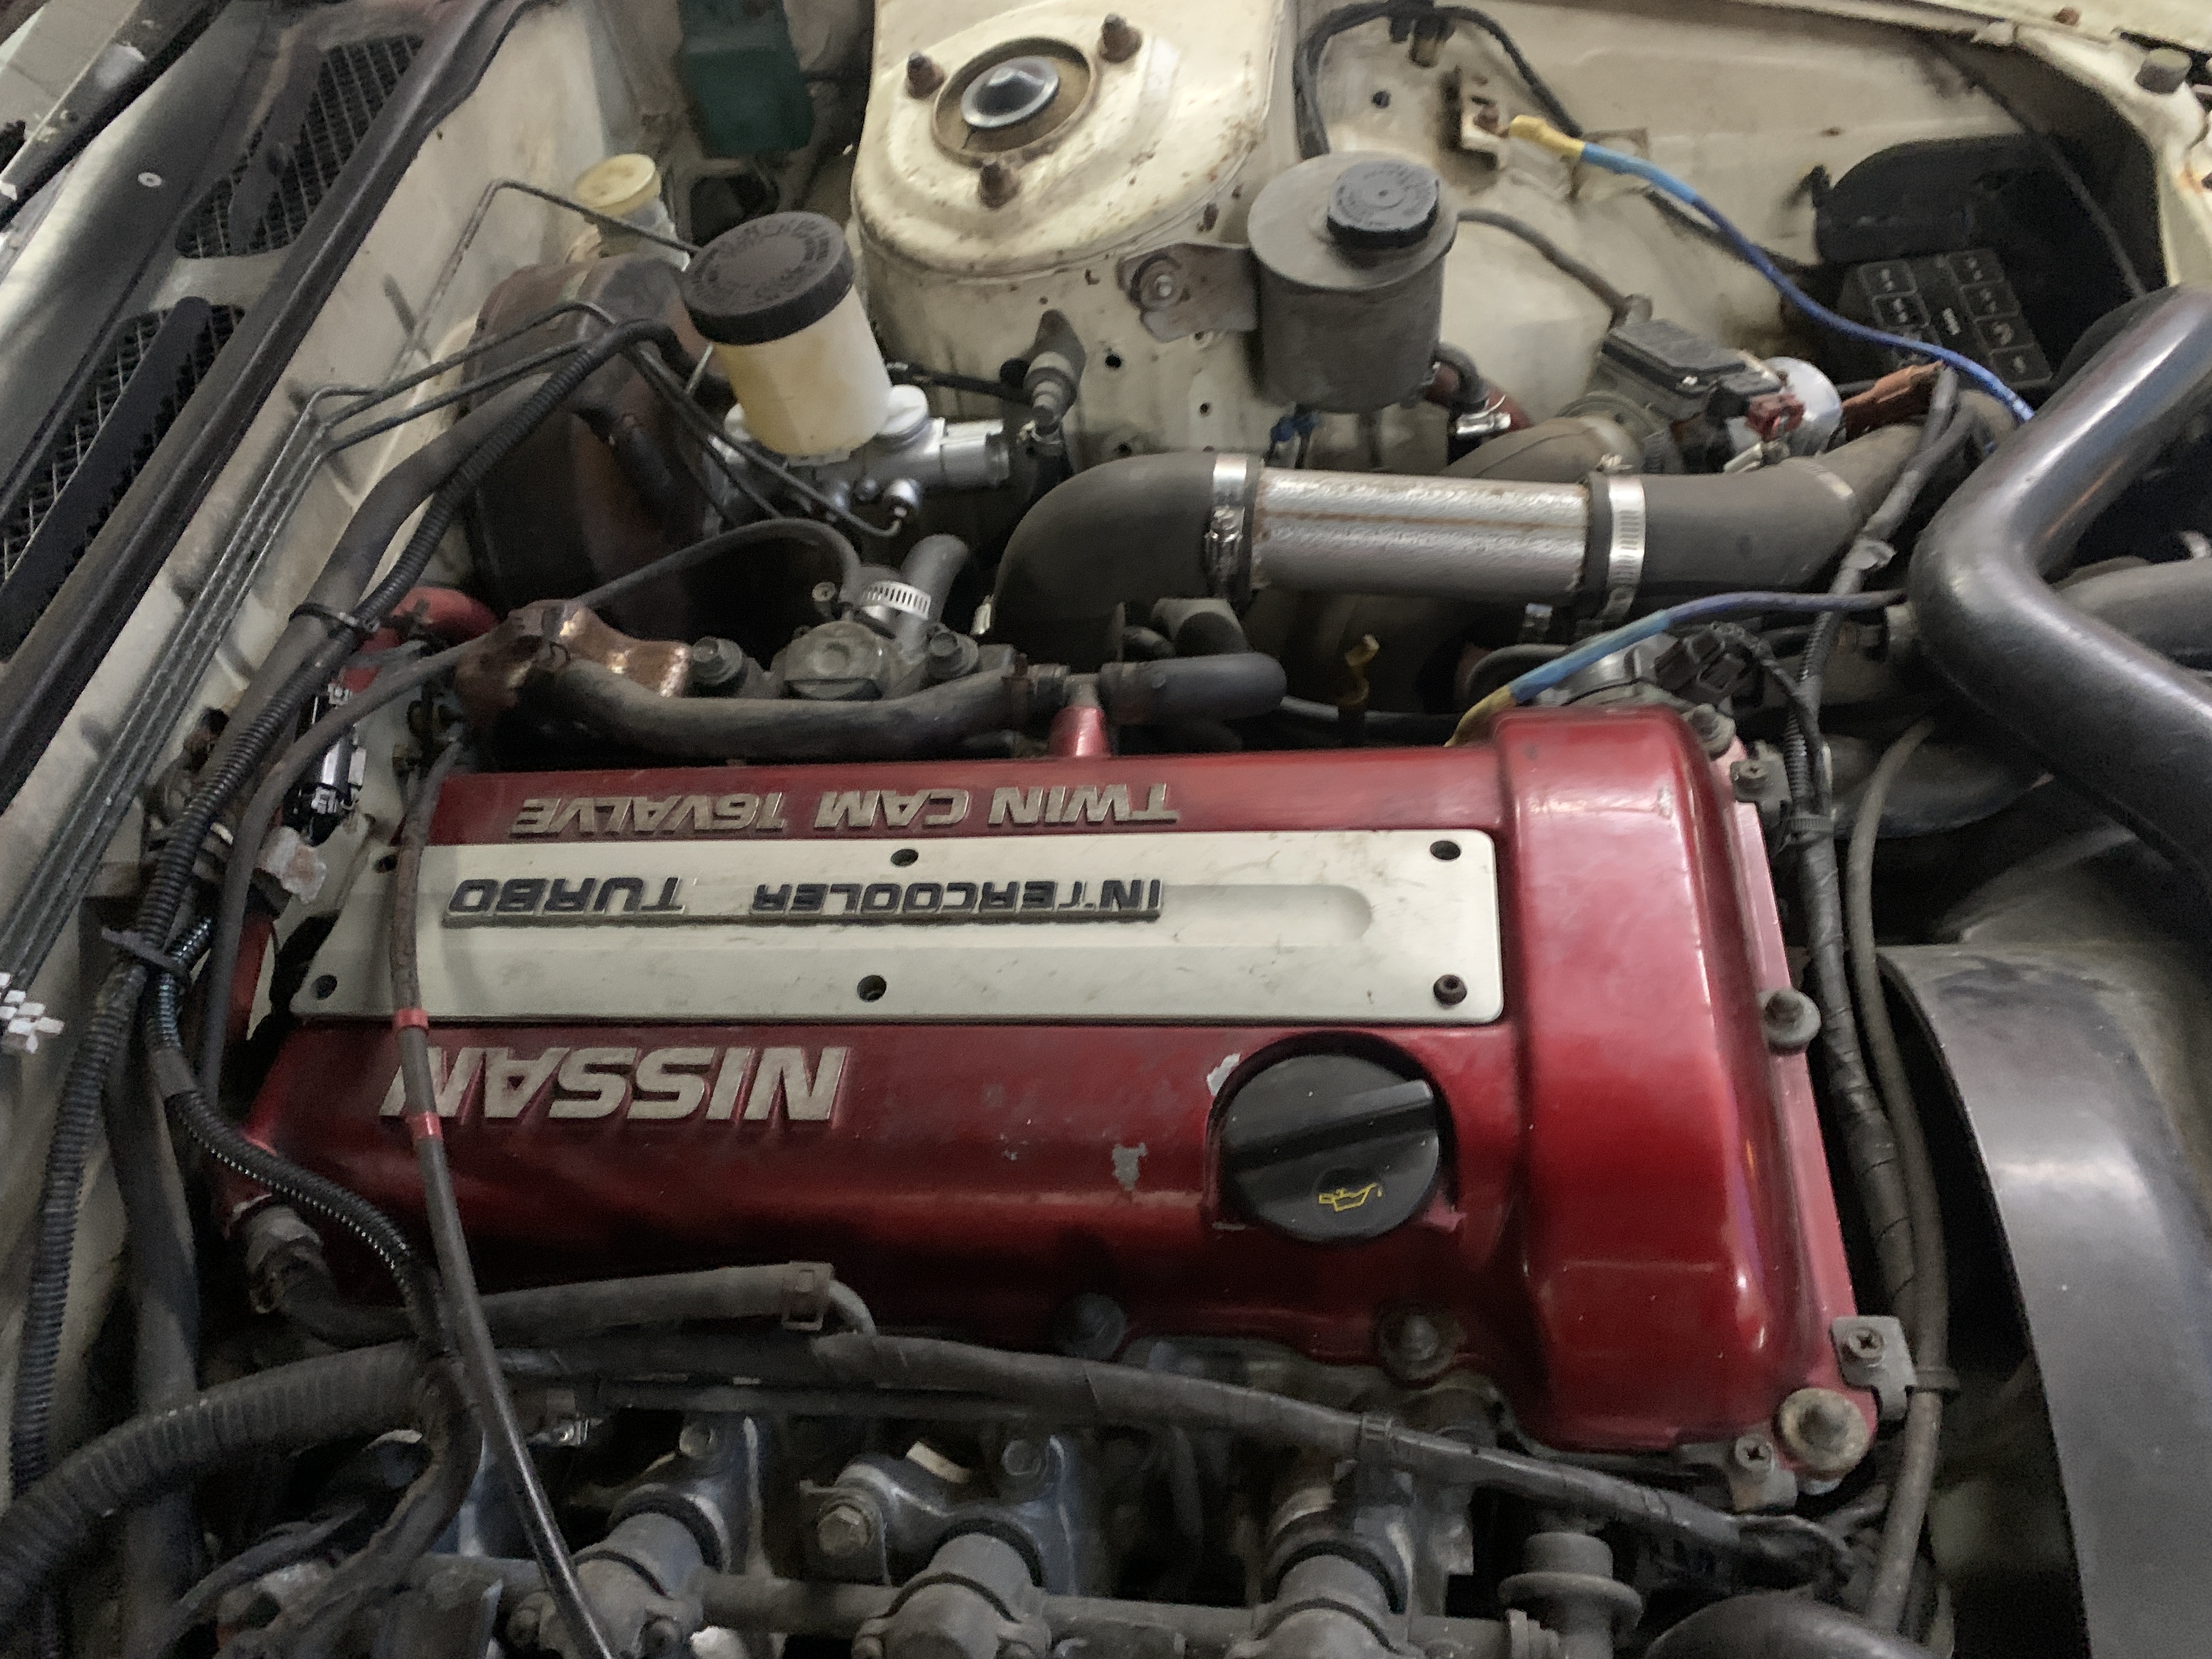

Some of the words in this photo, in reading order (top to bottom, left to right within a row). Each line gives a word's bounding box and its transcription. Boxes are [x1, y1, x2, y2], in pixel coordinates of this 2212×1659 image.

[509, 792, 788, 837] 16VALVE
[813, 789, 970, 830] CAM
[988, 783, 1180, 825] TWIN
[445, 876, 685, 916] TURBO
[750, 879, 1163, 915] INTERCOOLER
[379, 1046, 849, 1120] NISSAN
